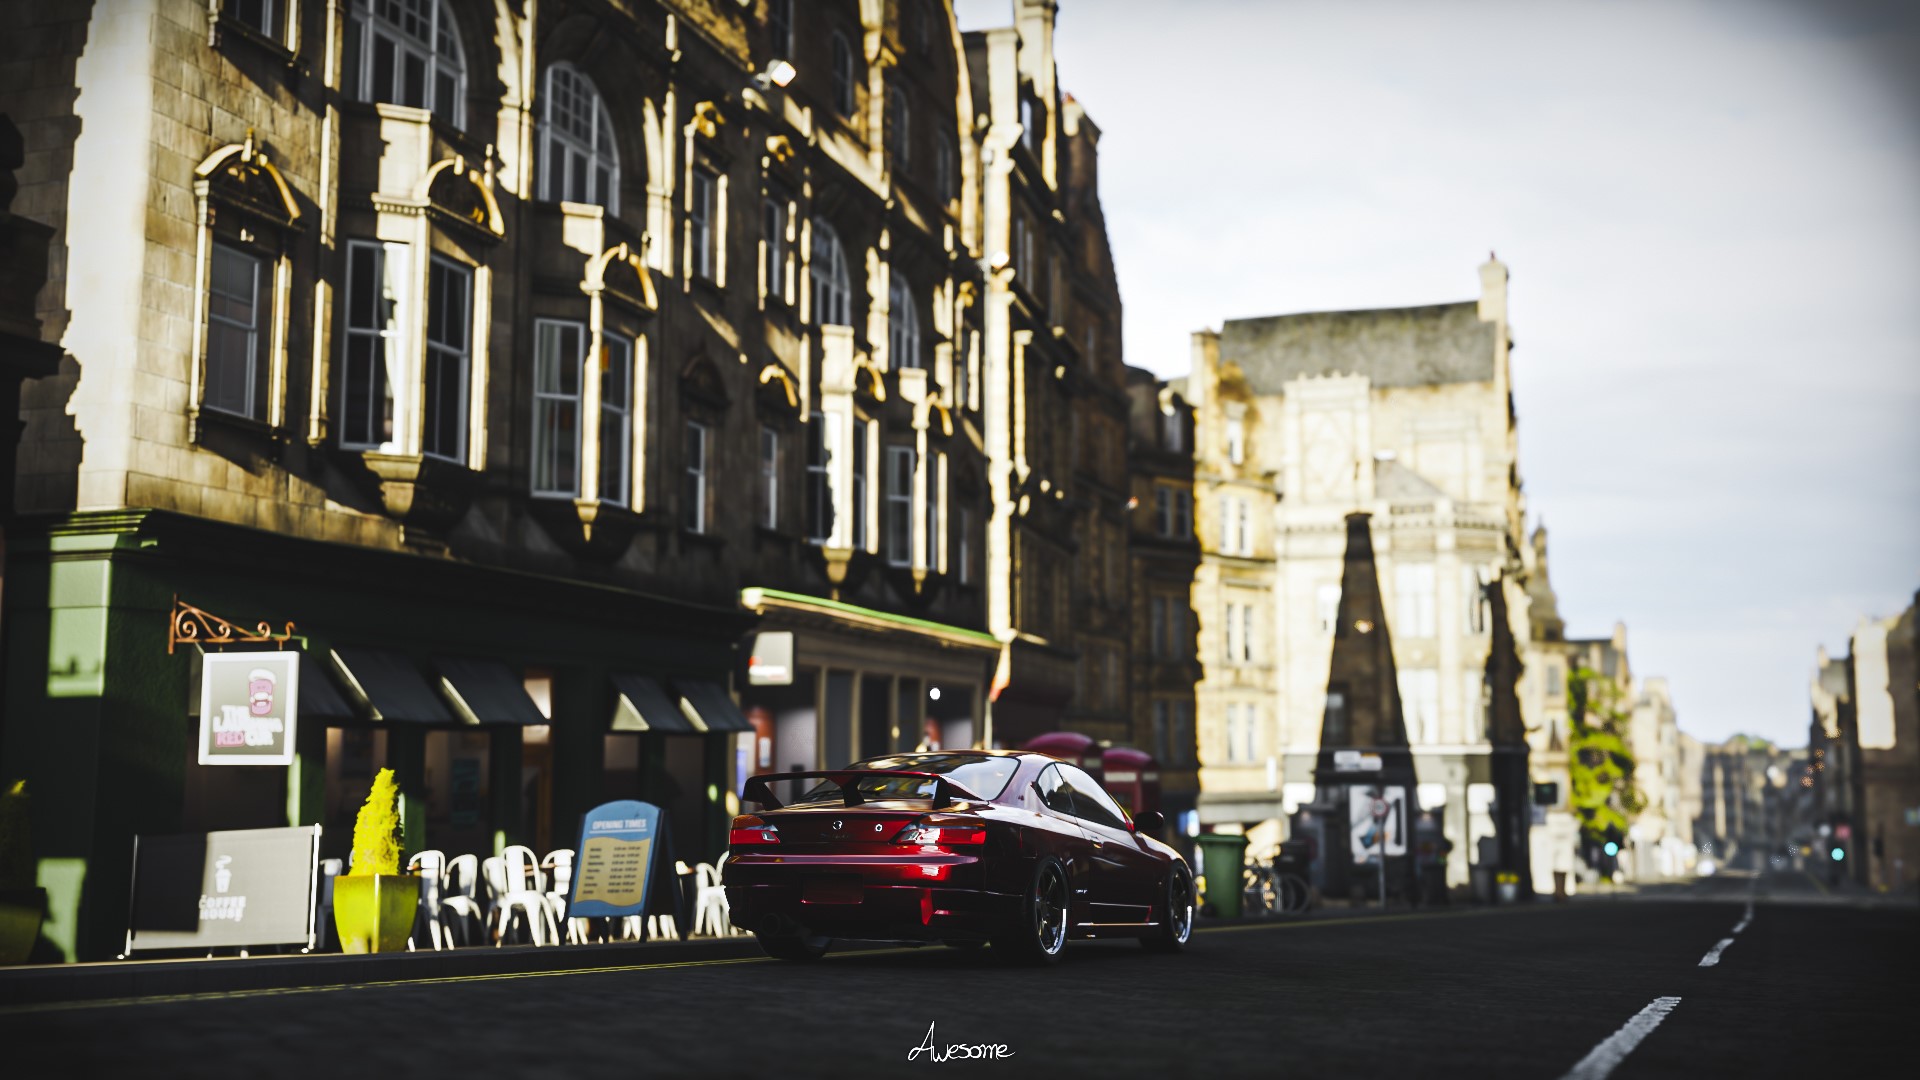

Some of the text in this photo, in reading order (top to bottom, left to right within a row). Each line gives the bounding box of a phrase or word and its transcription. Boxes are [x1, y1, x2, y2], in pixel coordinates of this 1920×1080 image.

[592, 819, 647, 830] OPENING TIMES
[199, 895, 246, 909] COFFEE
